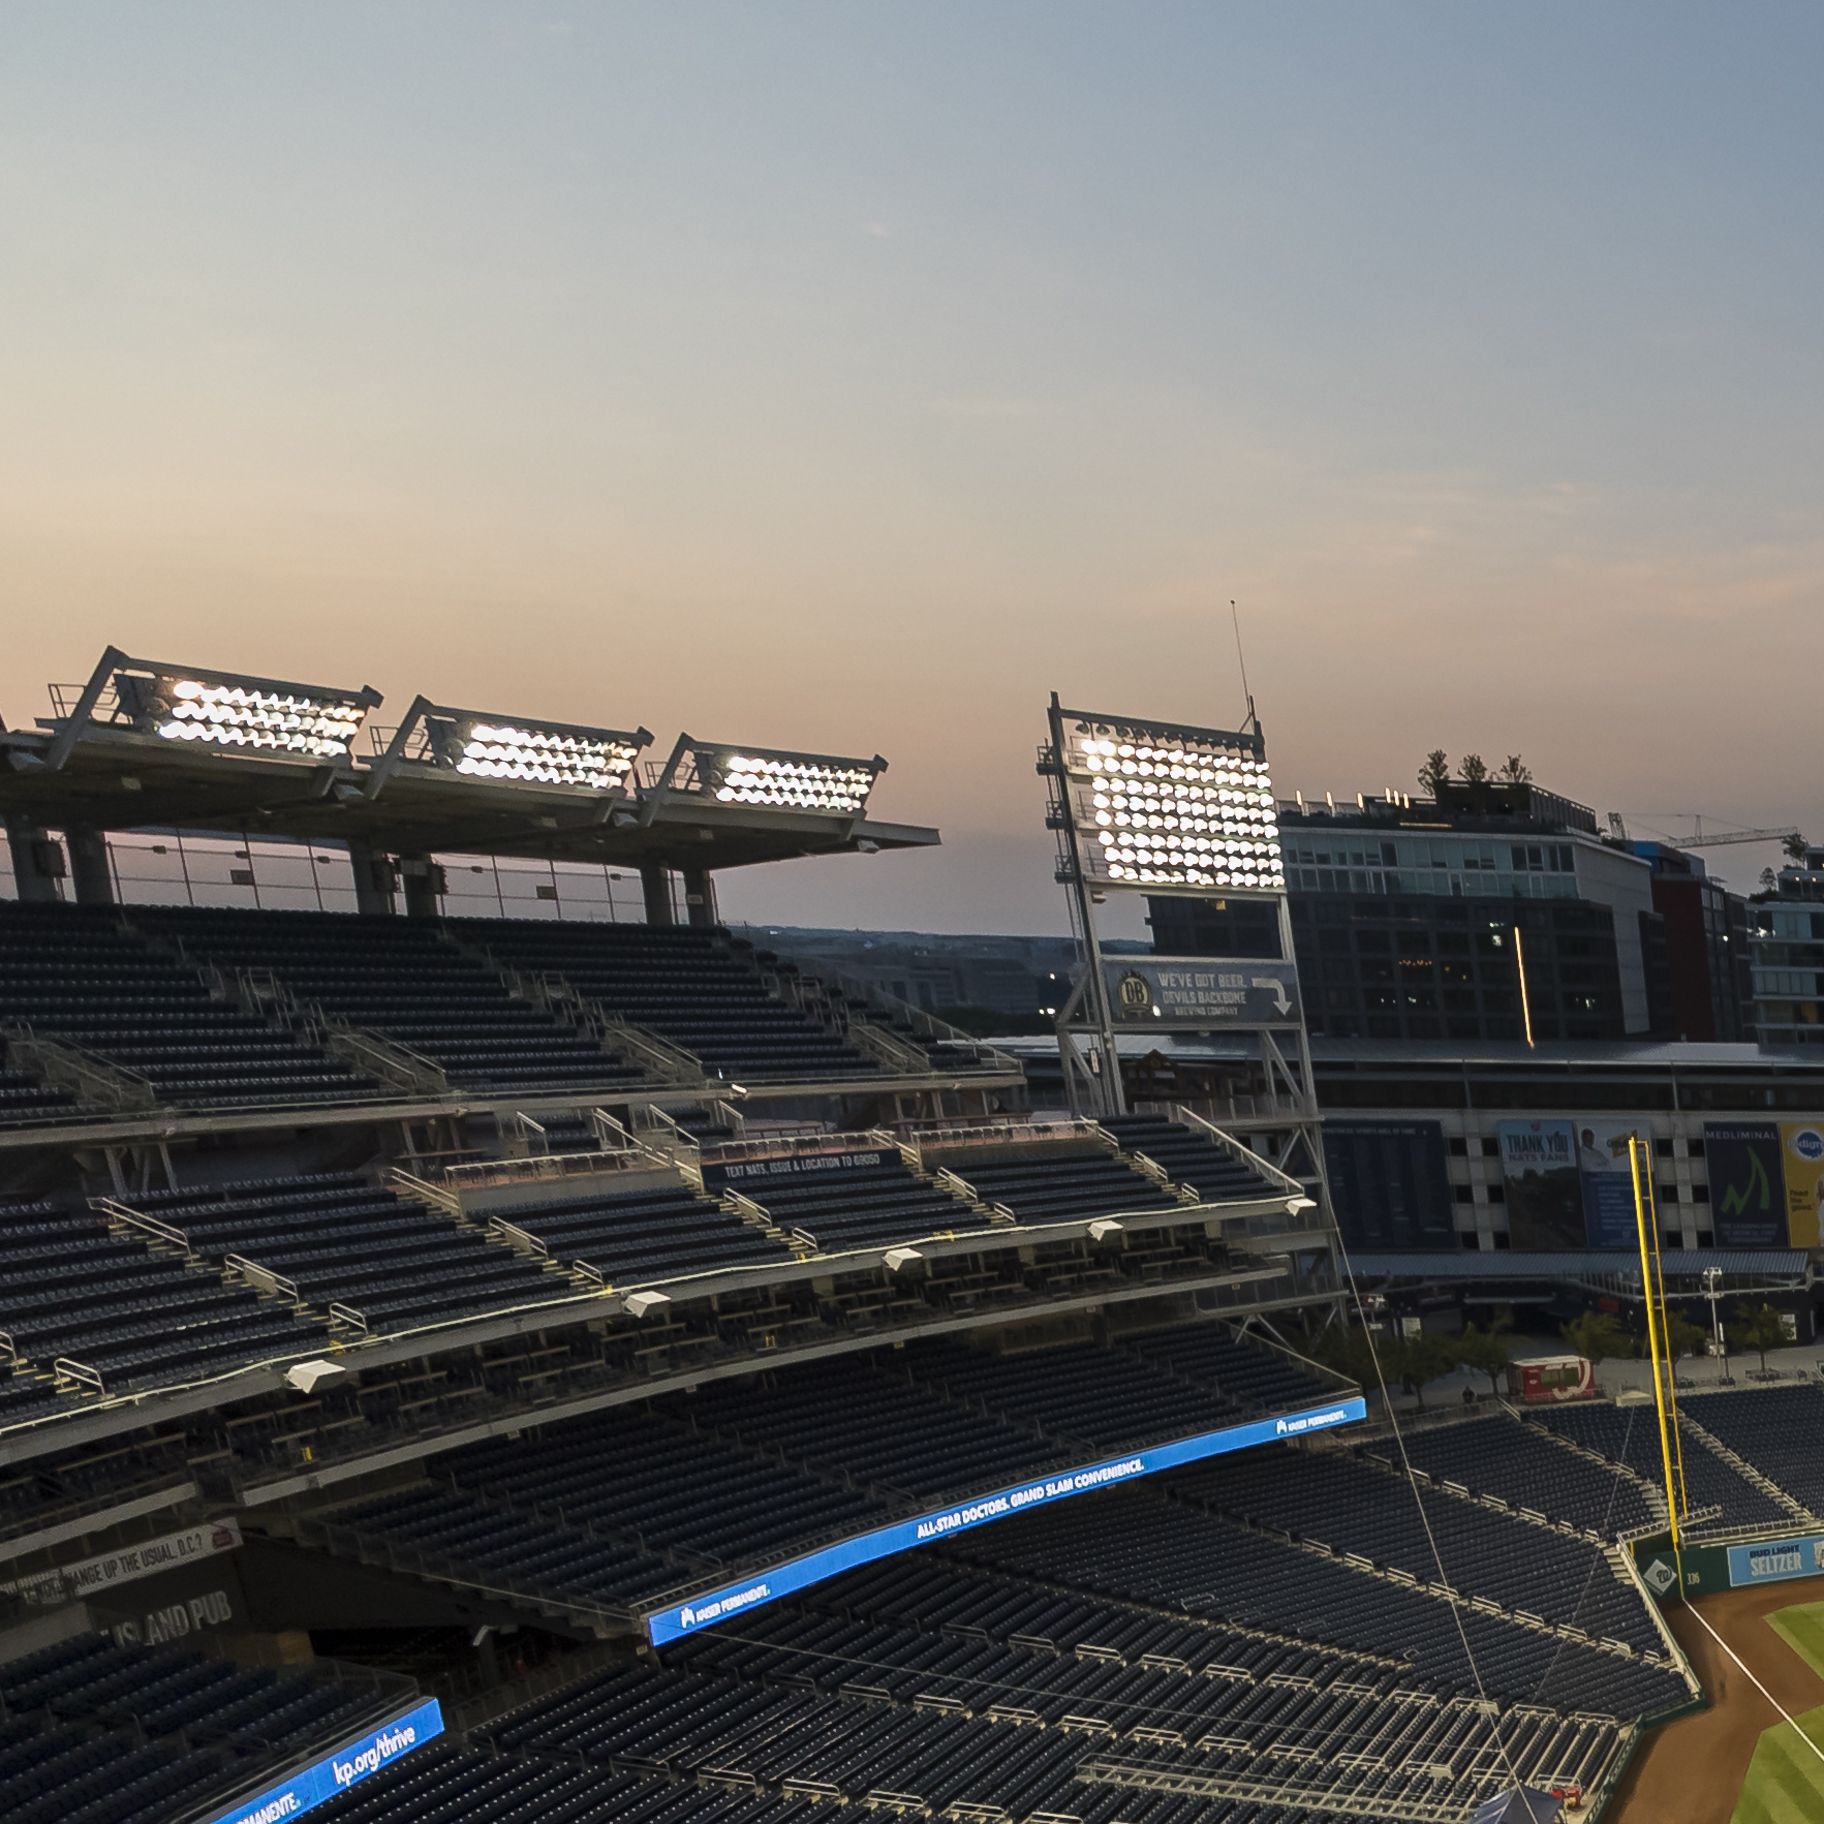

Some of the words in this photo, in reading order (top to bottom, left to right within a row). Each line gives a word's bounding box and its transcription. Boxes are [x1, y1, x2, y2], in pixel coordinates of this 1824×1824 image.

[1158, 973, 1192, 987] WE'VE
[1507, 1134, 1544, 1152] THANK
[1547, 1132, 1569, 1152] YOU
[1705, 1131, 1777, 1140] MEDLIMINAL
[725, 1165, 745, 1177] TEXT
[801, 1156, 840, 1171] LOCATION
[1508, 1154, 1537, 1163] NATS
[1540, 1154, 1569, 1163] FANS
[917, 1511, 961, 1538] ALL-STAR
[962, 1498, 1009, 1526] DOCTORS.
[1010, 1488, 1045, 1509] GRAND
[1045, 1477, 1073, 1500] SLAM
[1074, 1458, 1144, 1492] CONVENIENCE.
[1750, 1549, 1771, 1558] BUD
[1772, 1544, 1800, 1556] LIGHT
[1751, 1552, 1802, 1576] SELTZER
[190, 1590, 232, 1630] PUB
[331, 1725, 417, 1788] kp.org/thrive
